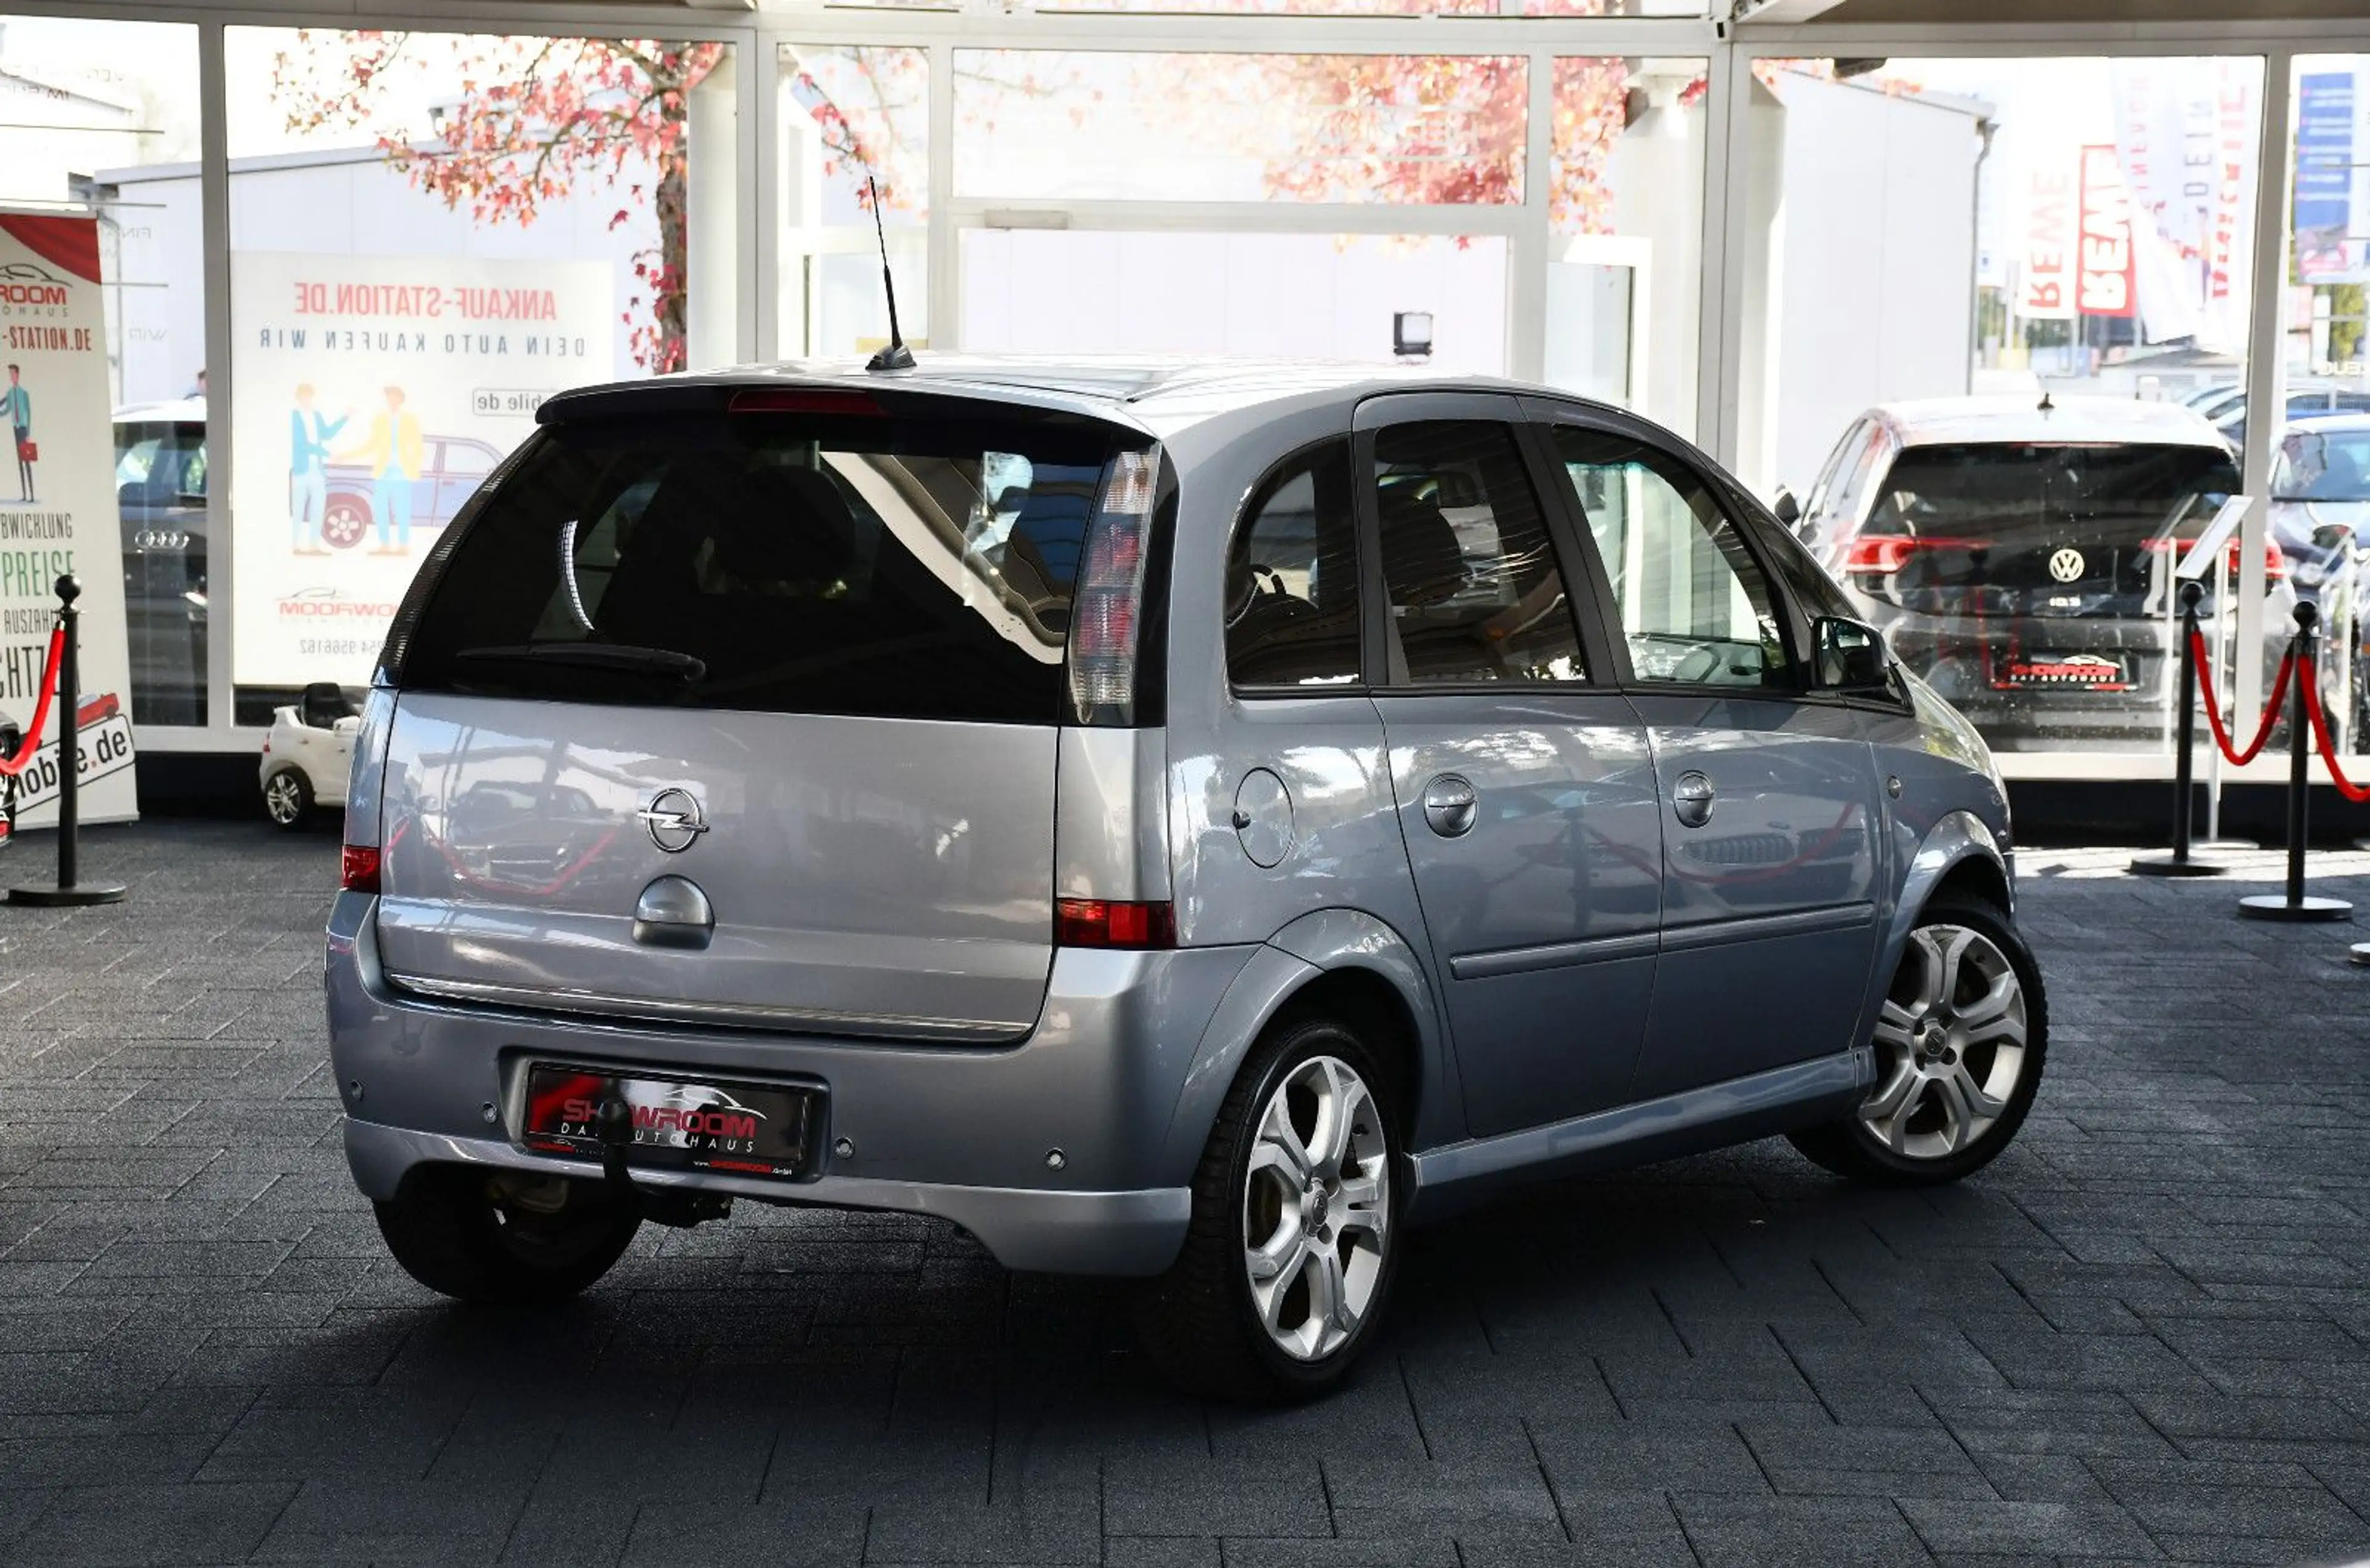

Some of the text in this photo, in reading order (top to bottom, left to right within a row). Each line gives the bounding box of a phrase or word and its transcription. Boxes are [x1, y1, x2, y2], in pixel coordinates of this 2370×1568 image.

[562, 1098, 757, 1138] SHWROOM
[561, 1123, 754, 1153] DA UTOHAUS
